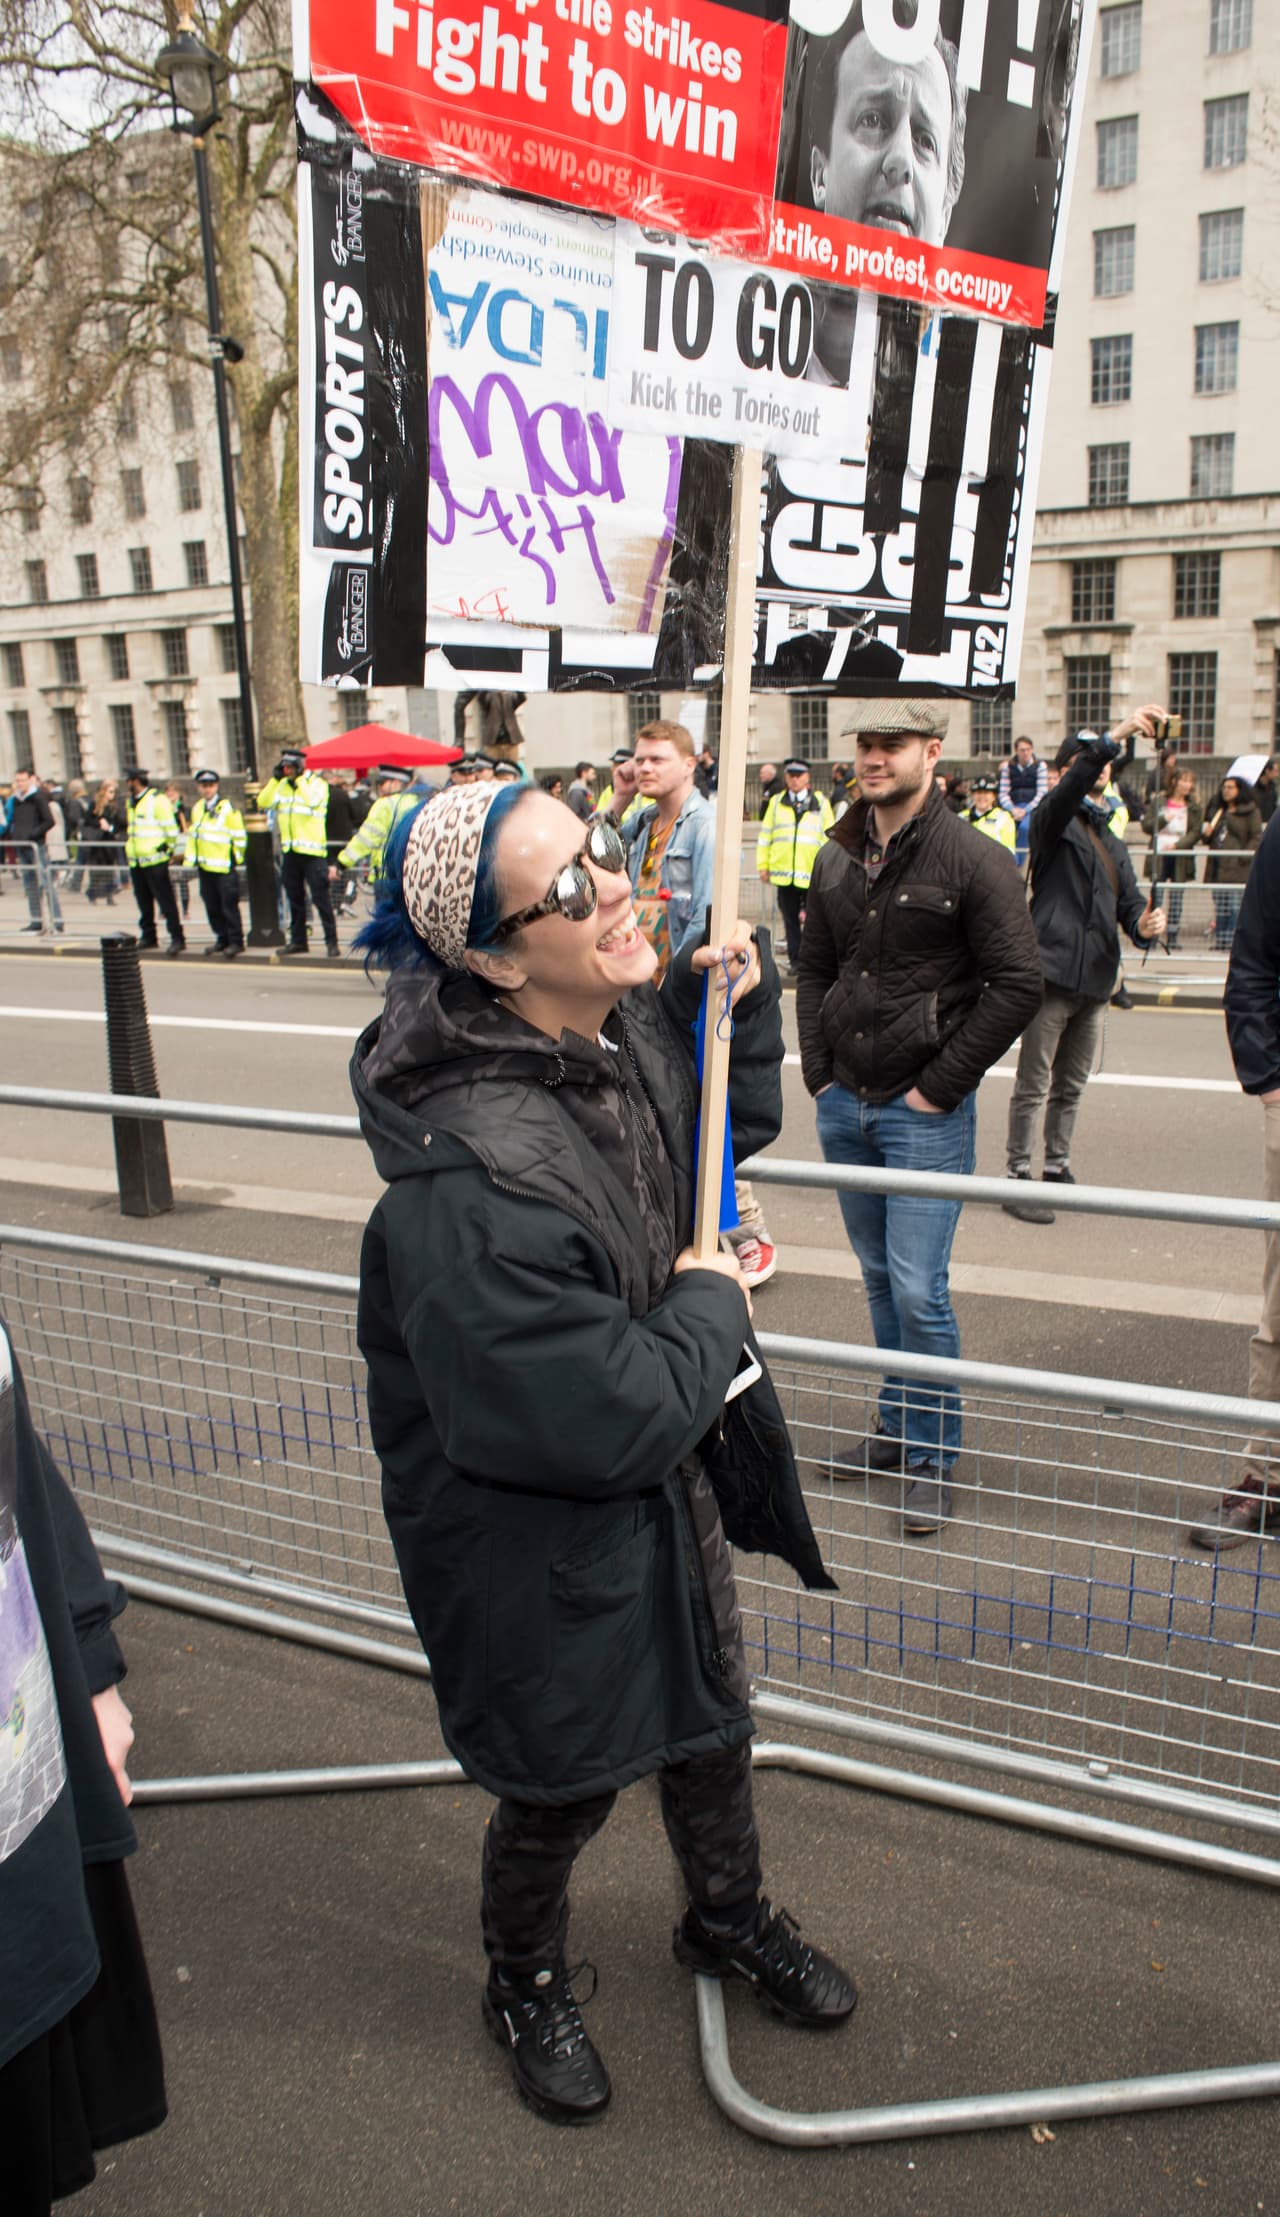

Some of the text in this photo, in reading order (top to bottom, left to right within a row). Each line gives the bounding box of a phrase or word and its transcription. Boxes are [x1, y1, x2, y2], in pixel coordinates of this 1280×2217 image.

[376, 0, 738, 162] Fight to win
[624, 6, 742, 83] strikes
[347, 171, 363, 251] BANGER
[500, 220, 547, 246] People
[635, 251, 812, 378] TO GO
[845, 243, 929, 294] protest,
[935, 268, 1013, 311] occupy
[322, 280, 365, 540] SPORTS
[630, 370, 820, 437] Kick the Tories out
[350, 574, 365, 645] BANGER
